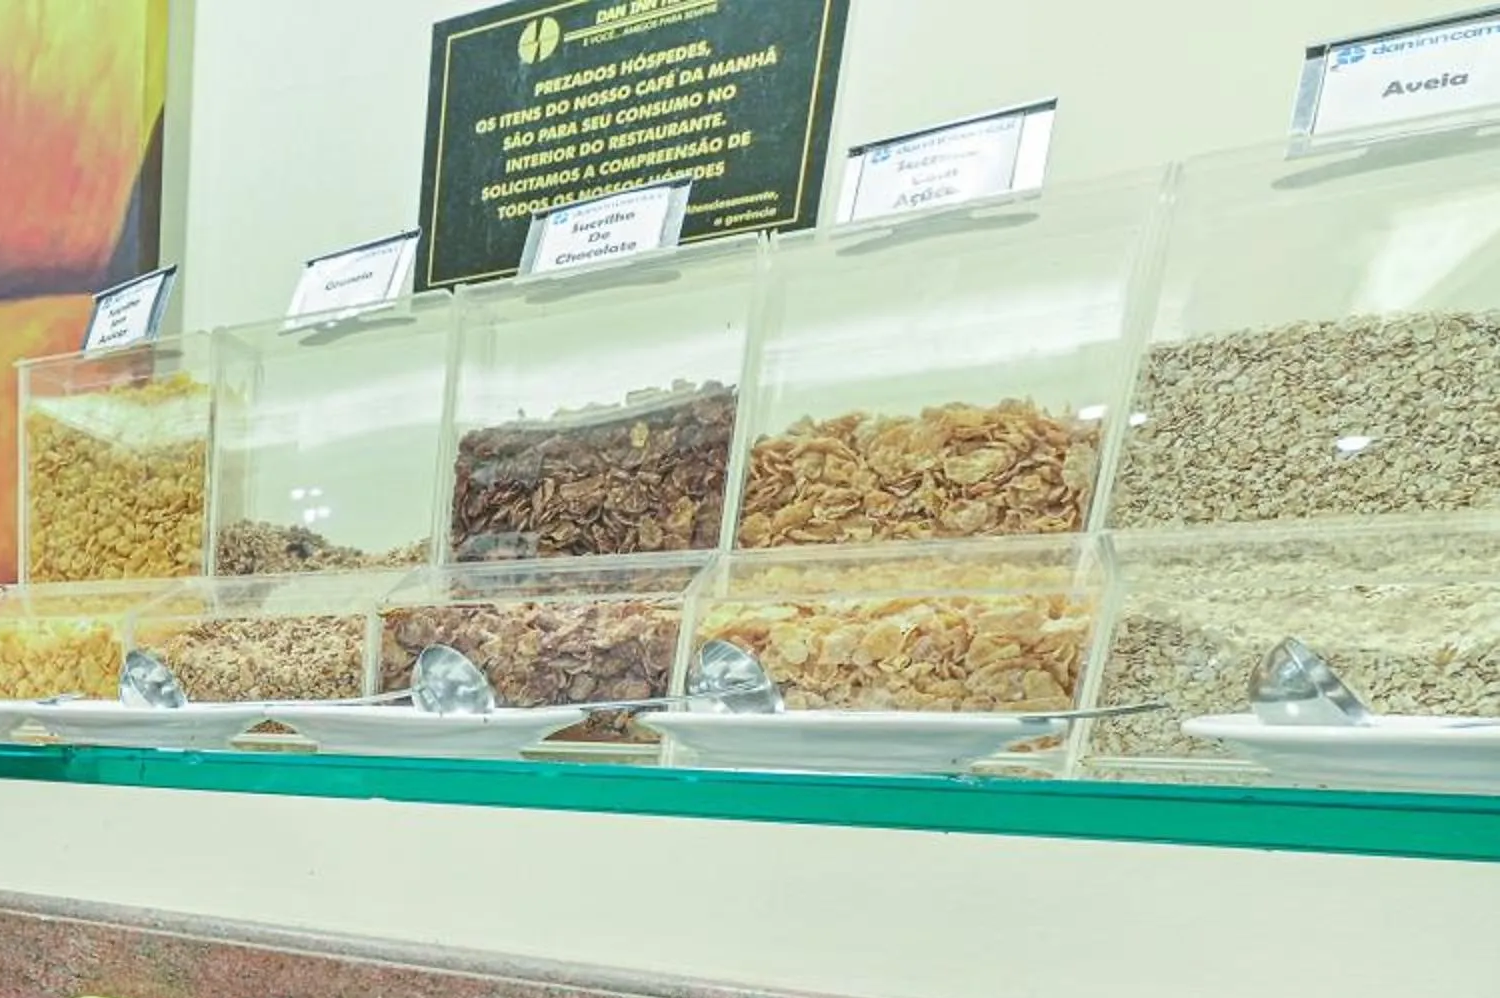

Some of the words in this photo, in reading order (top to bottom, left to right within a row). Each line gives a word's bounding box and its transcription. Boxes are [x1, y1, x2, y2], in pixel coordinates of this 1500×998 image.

[596, 3, 627, 24] DAN
[535, 63, 617, 96] PREZADOS
[620, 40, 711, 75] HÓSPEDES,
[1381, 72, 1469, 98] Aveia
[475, 117, 497, 134] OS
[499, 106, 542, 128] ITENS
[545, 100, 570, 117] DO
[573, 85, 631, 111] NOSSO
[635, 70, 676, 96] CAFÉ
[679, 67, 704, 86] DA
[502, 131, 535, 151] SÃO
[537, 121, 578, 143] PARA
[581, 113, 612, 133] SEU
[615, 92, 703, 124] CONSUMO
[707, 83, 737, 104] NO
[481, 167, 580, 201] SOLICITAMOS
[583, 164, 595, 179] A
[599, 136, 723, 175] COMPREENSÃO
[727, 130, 752, 149] DE
[505, 144, 577, 173] INTERIOR
[579, 139, 604, 156] DO
[608, 111, 727, 150] RESTAURANTE.
[497, 196, 550, 220] TODOS
[553, 191, 575, 207] OS
[555, 241, 637, 265] Chocolate
